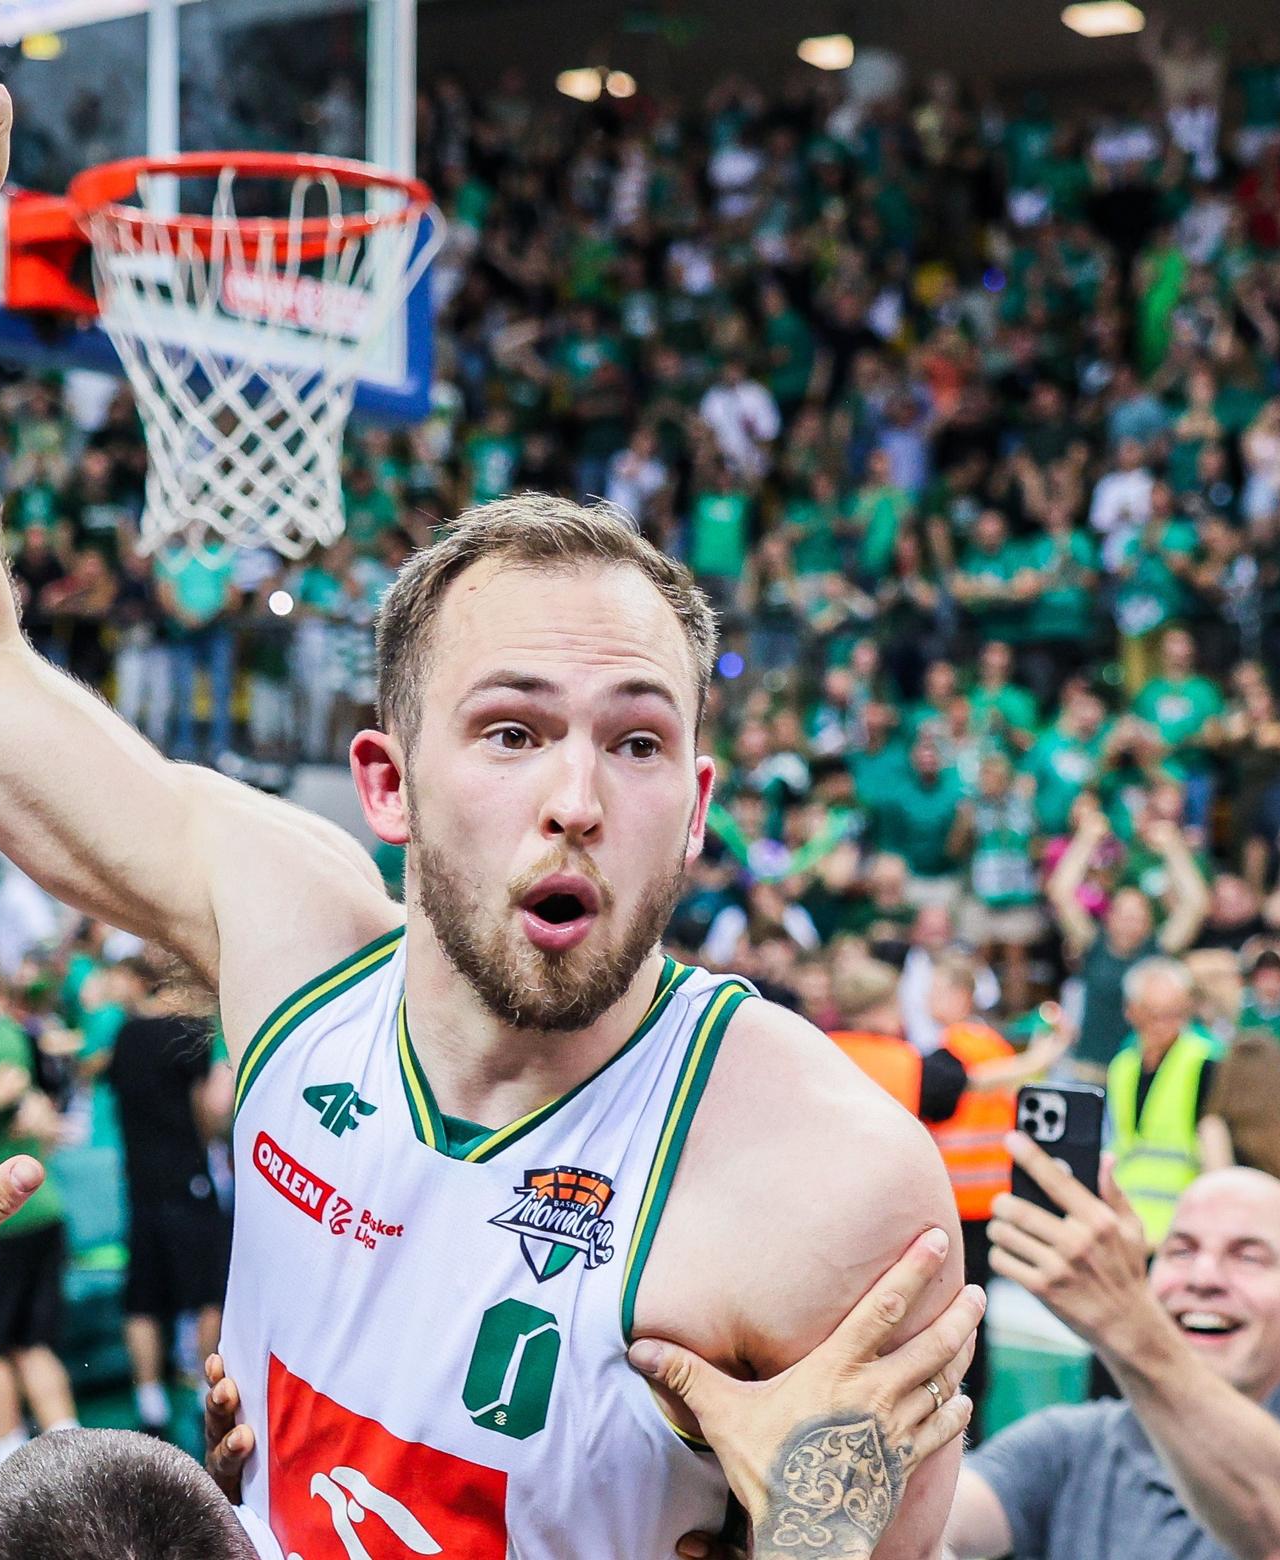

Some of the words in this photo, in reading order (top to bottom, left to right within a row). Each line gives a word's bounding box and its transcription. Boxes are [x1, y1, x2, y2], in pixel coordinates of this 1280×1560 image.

[302, 1082, 379, 1138] 4F
[257, 1142, 323, 1210] ORLEN
[360, 1209, 404, 1237] Bsket
